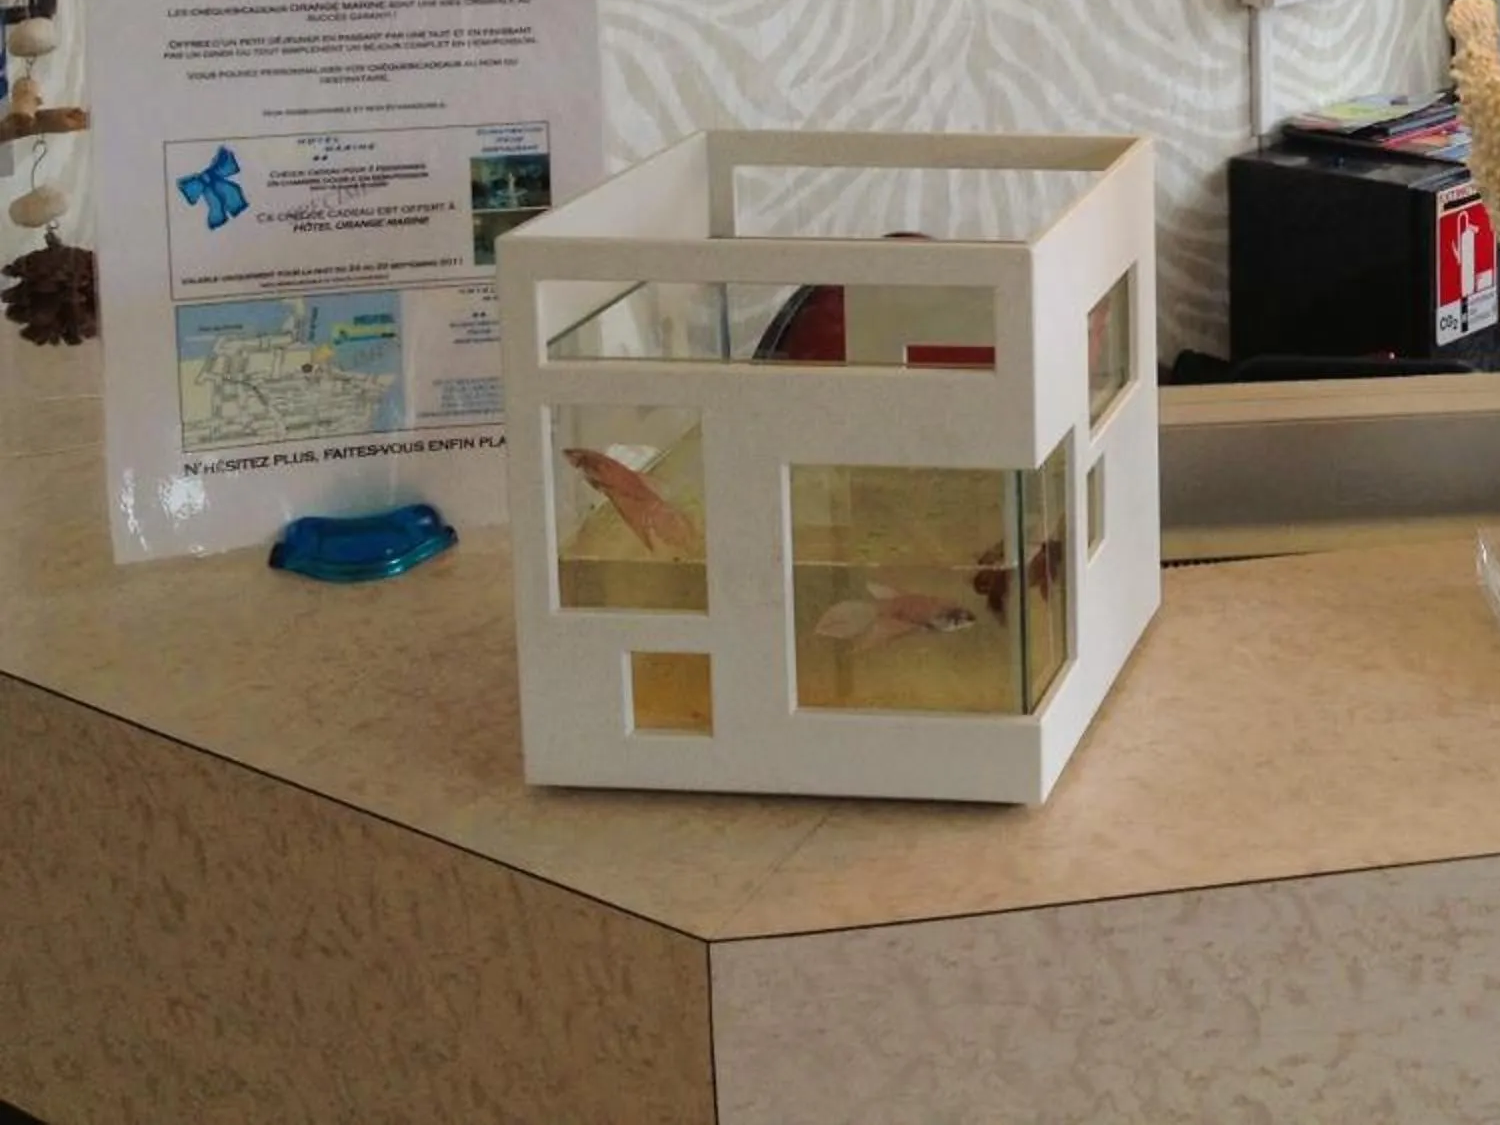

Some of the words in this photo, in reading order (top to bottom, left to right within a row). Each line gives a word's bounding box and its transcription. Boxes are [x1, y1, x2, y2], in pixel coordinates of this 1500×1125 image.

[183, 455, 270, 476] N'HÉSITEZ
[273, 450, 319, 466] PLUS,
[428, 438, 474, 452] ENFIN
